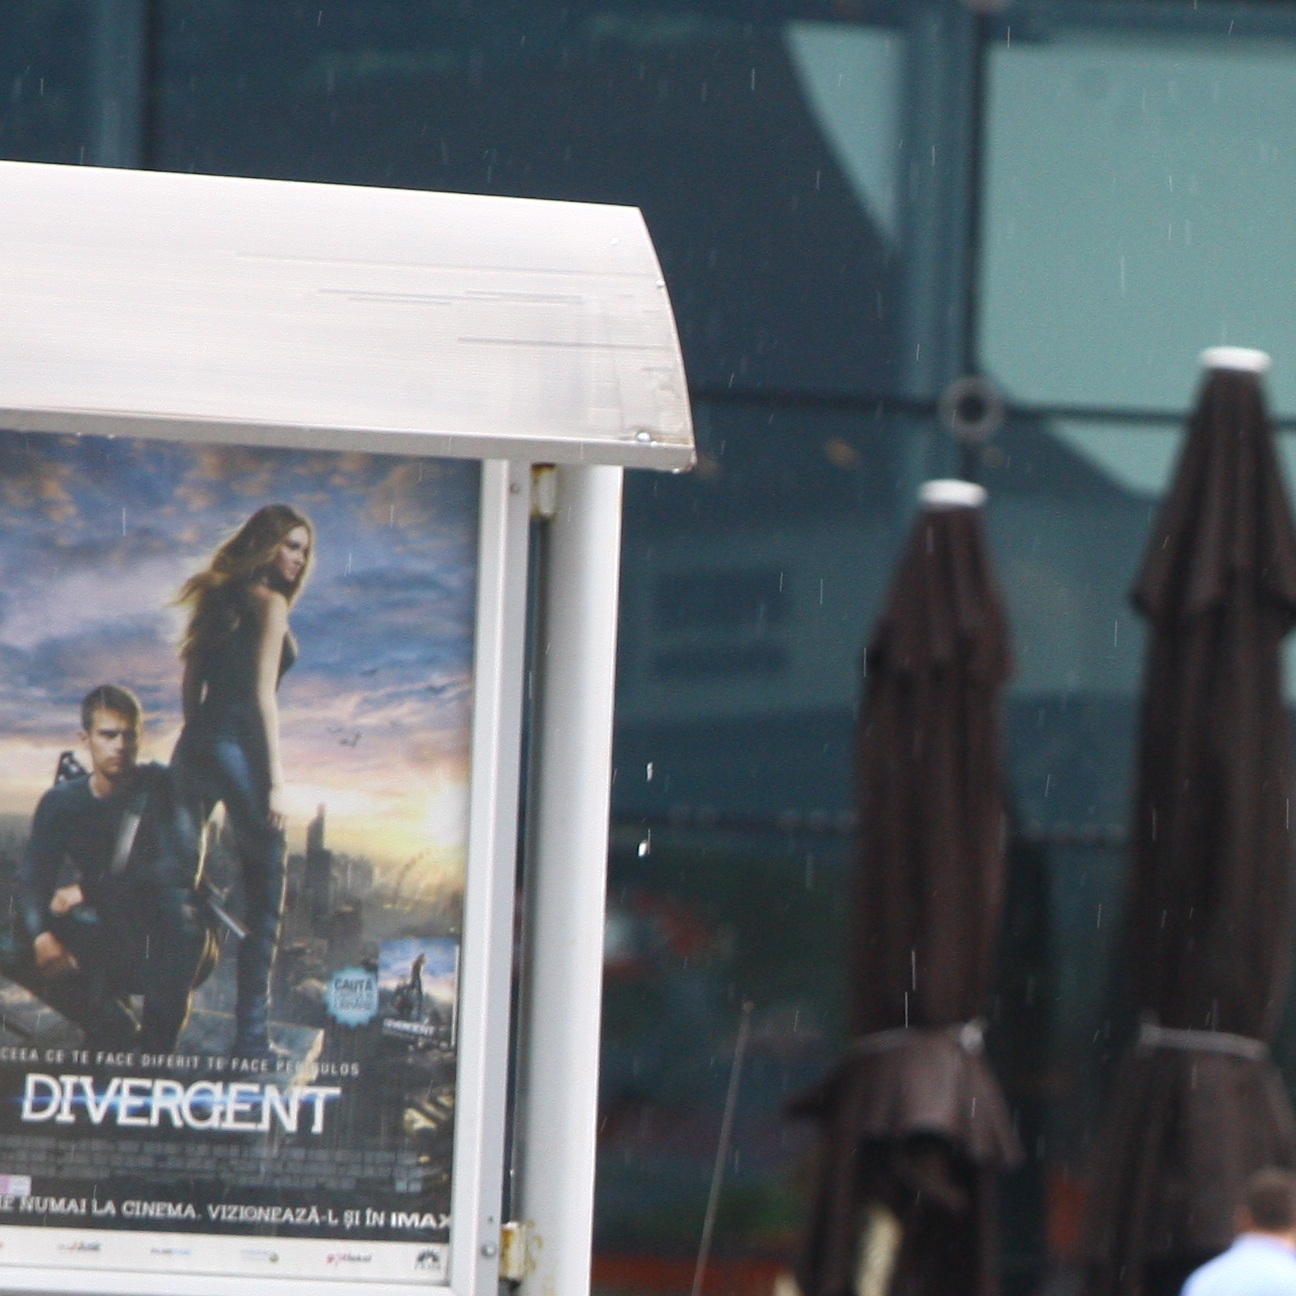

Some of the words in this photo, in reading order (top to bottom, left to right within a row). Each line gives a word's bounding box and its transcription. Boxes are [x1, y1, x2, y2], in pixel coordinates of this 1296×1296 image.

[45, 1048, 64, 1063] CE
[73, 1050, 88, 1065] TE
[97, 1051, 134, 1067] FACE
[142, 1053, 199, 1070] DIFERIT
[207, 1056, 224, 1071] TE
[232, 1057, 269, 1073] FACE
[21, 1072, 341, 1135] DIVERGENT
[19, 1196, 87, 1214] NUMAI
[92, 1199, 116, 1216] LA
[390, 1211, 450, 1229] IMAX
